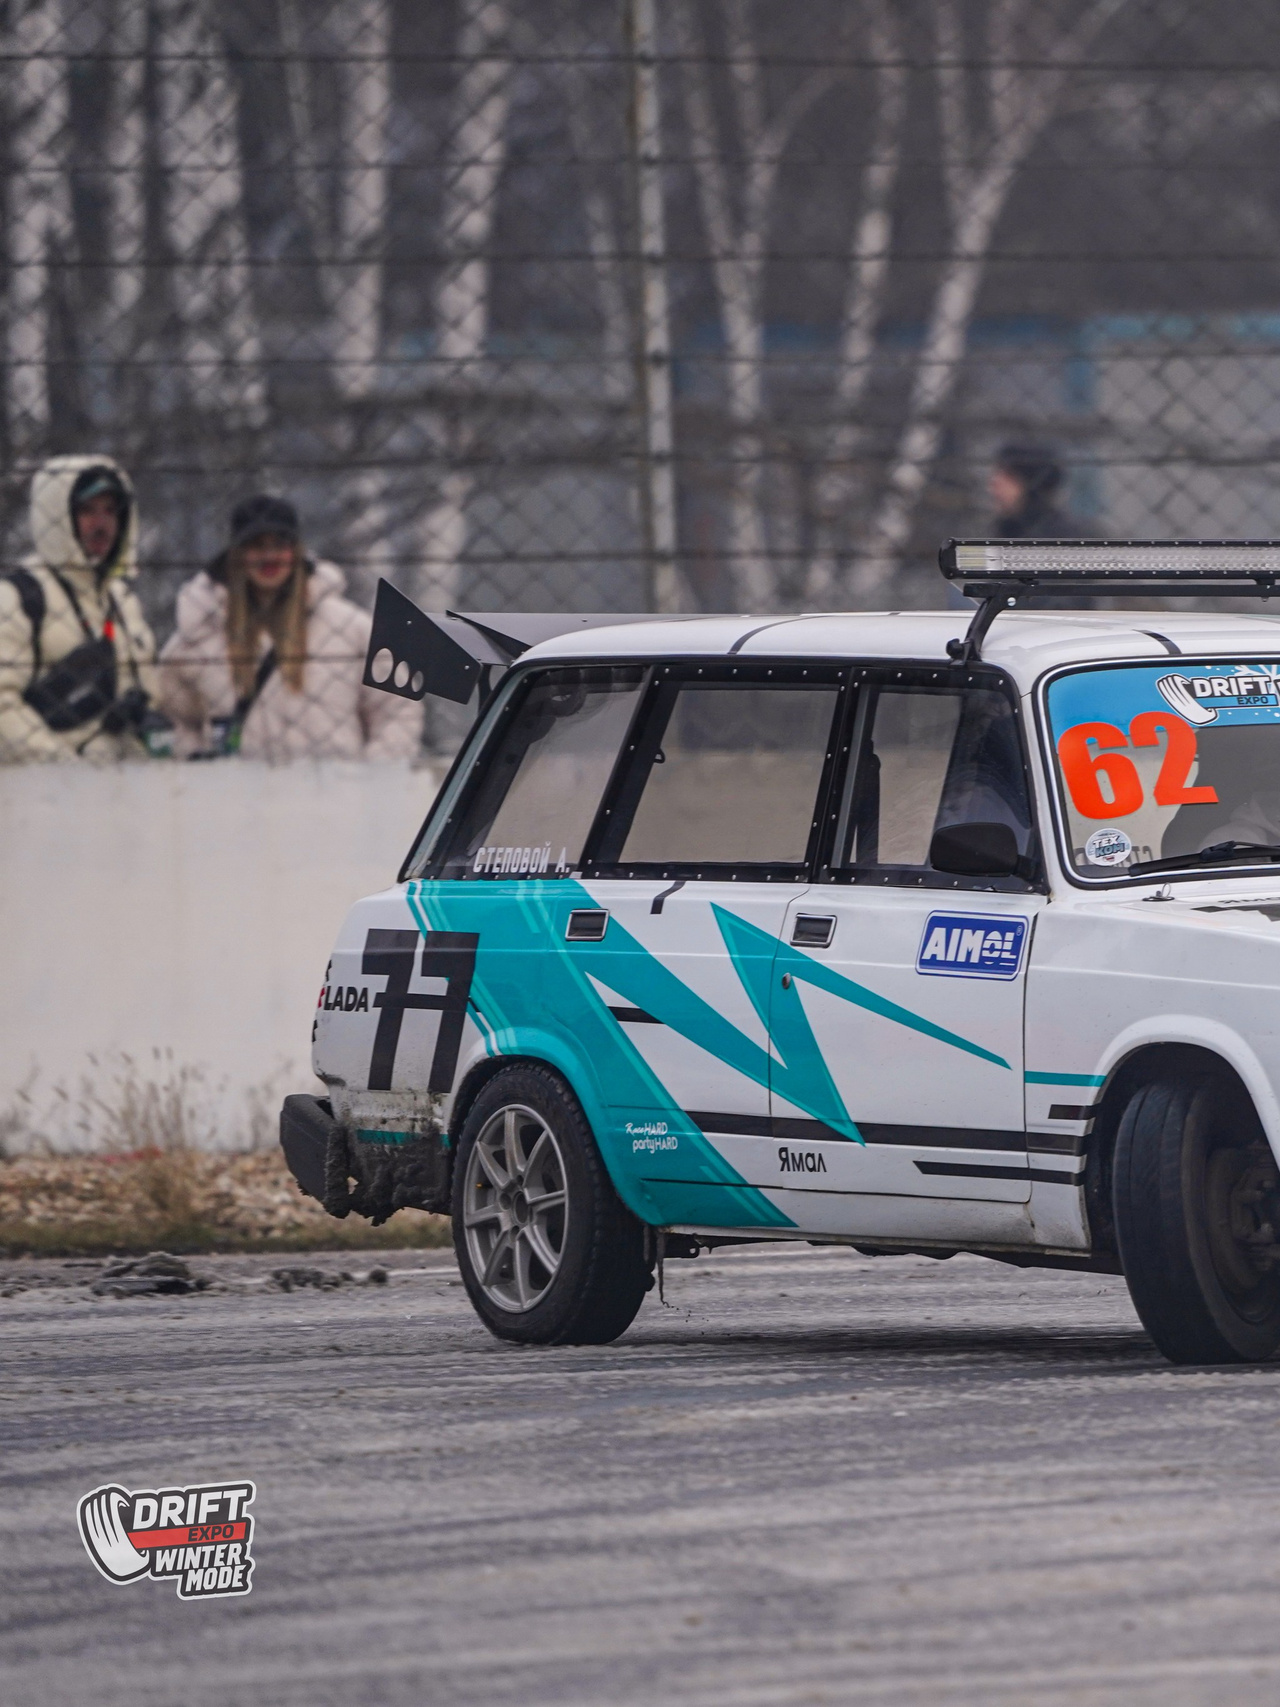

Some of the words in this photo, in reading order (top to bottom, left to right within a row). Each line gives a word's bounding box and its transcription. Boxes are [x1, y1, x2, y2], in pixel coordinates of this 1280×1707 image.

[1192, 677, 1270, 698] DRIFT
[1237, 695, 1269, 705] EXPO
[1057, 711, 1219, 820] 62
[473, 841, 551, 873] СТЕПОВОЙ
[921, 927, 1018, 965] AIMOL
[324, 985, 369, 1012] LADA
